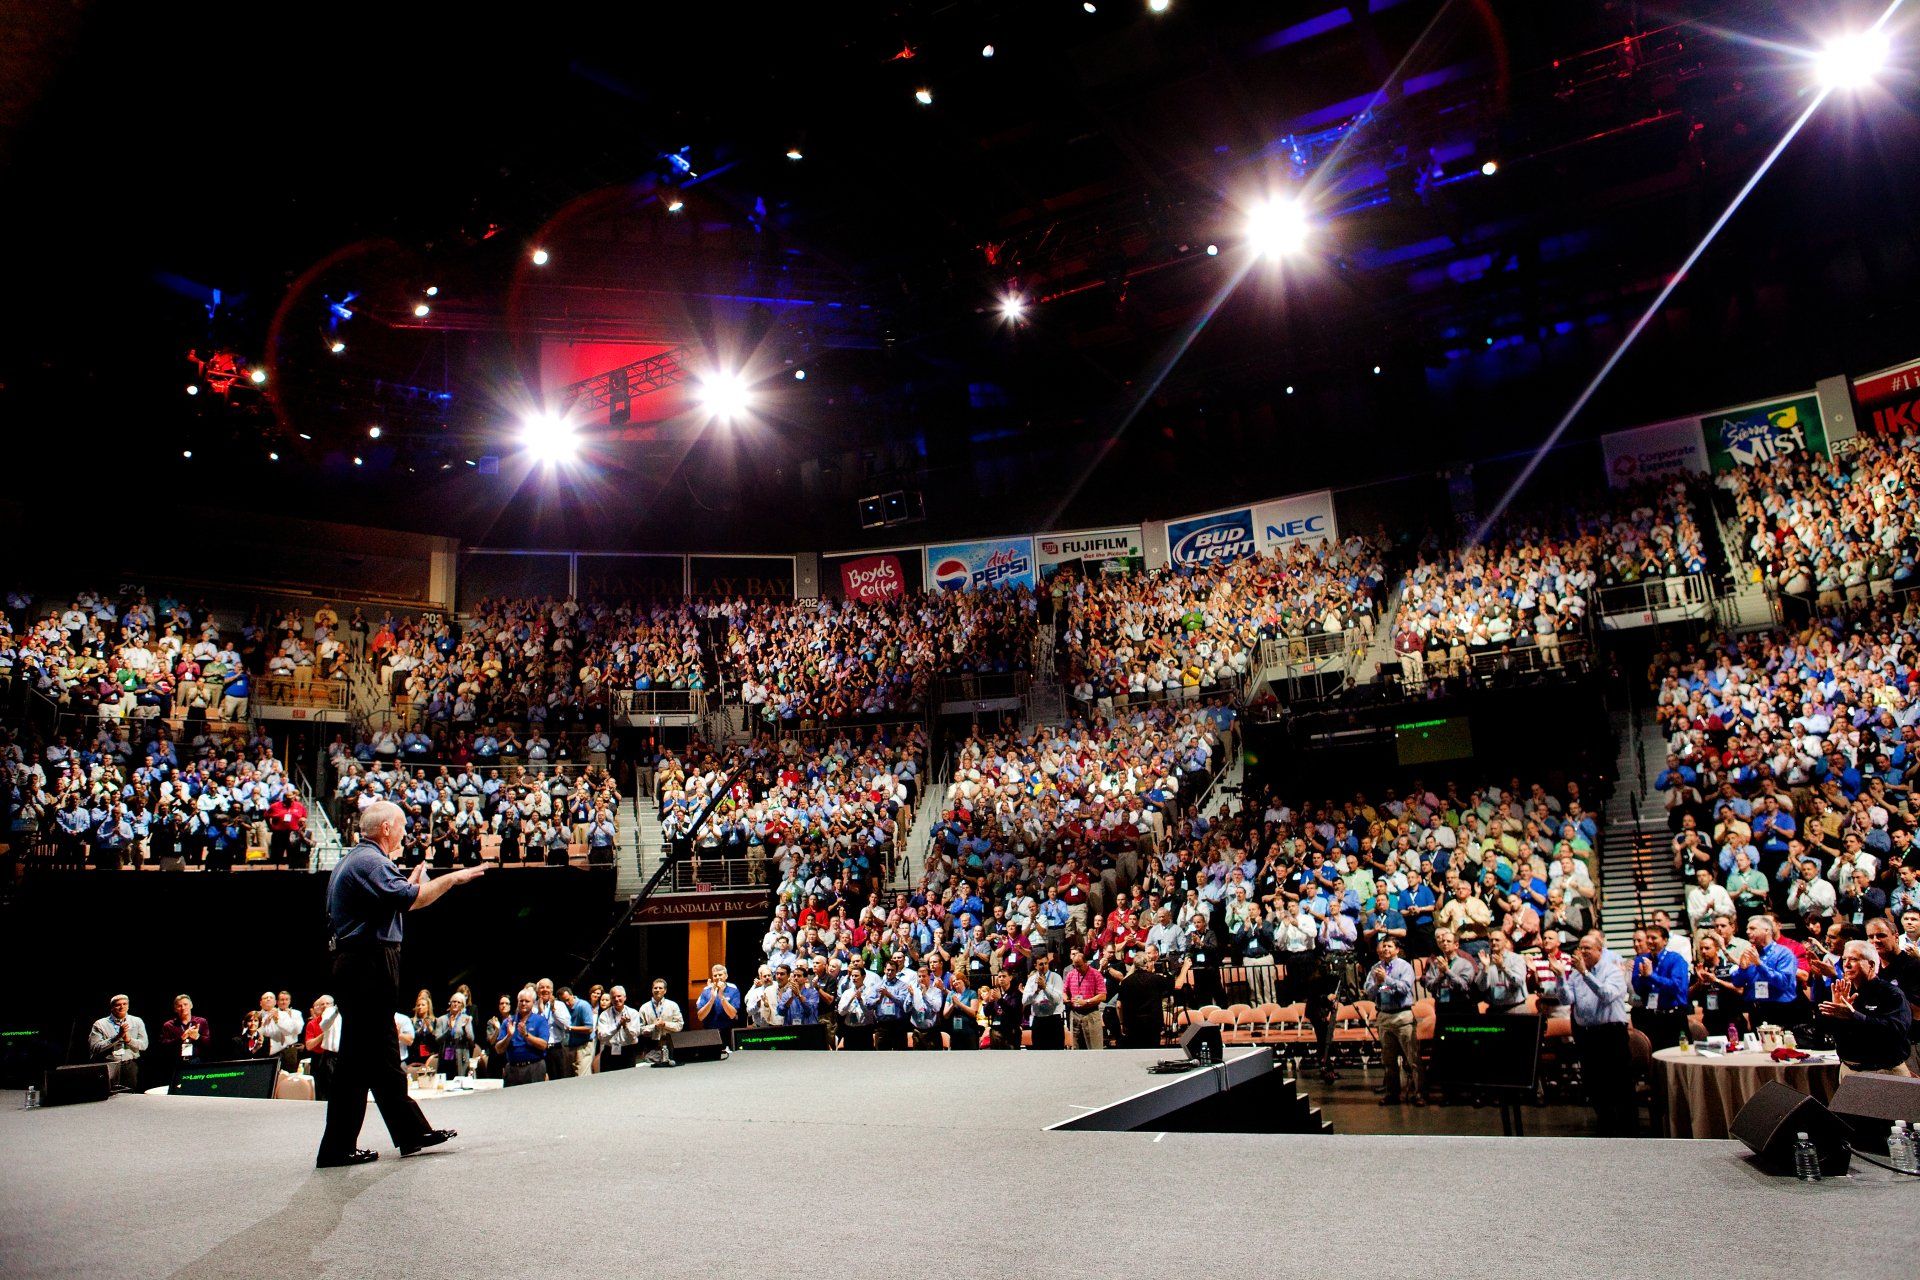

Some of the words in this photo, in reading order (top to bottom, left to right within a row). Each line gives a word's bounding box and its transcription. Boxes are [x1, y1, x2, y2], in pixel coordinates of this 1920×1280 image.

[1722, 425, 1806, 467] Mist
[1727, 425, 1769, 447] Sierra
[1638, 446, 1696, 463] Corporate
[1195, 527, 1245, 548] BUD
[1266, 515, 1325, 541] NEC
[1062, 537, 1128, 554] FUJIFILM
[1186, 540, 1255, 563] LIGHT
[986, 548, 1016, 568] diet
[848, 560, 895, 588] Boyds
[972, 557, 1028, 584] PEPSI
[747, 576, 793, 596] BAY
[860, 580, 898, 597] coffee
[799, 598, 817, 608] 202
[663, 902, 722, 914] MANDALAY
[724, 901, 744, 911] BAY
